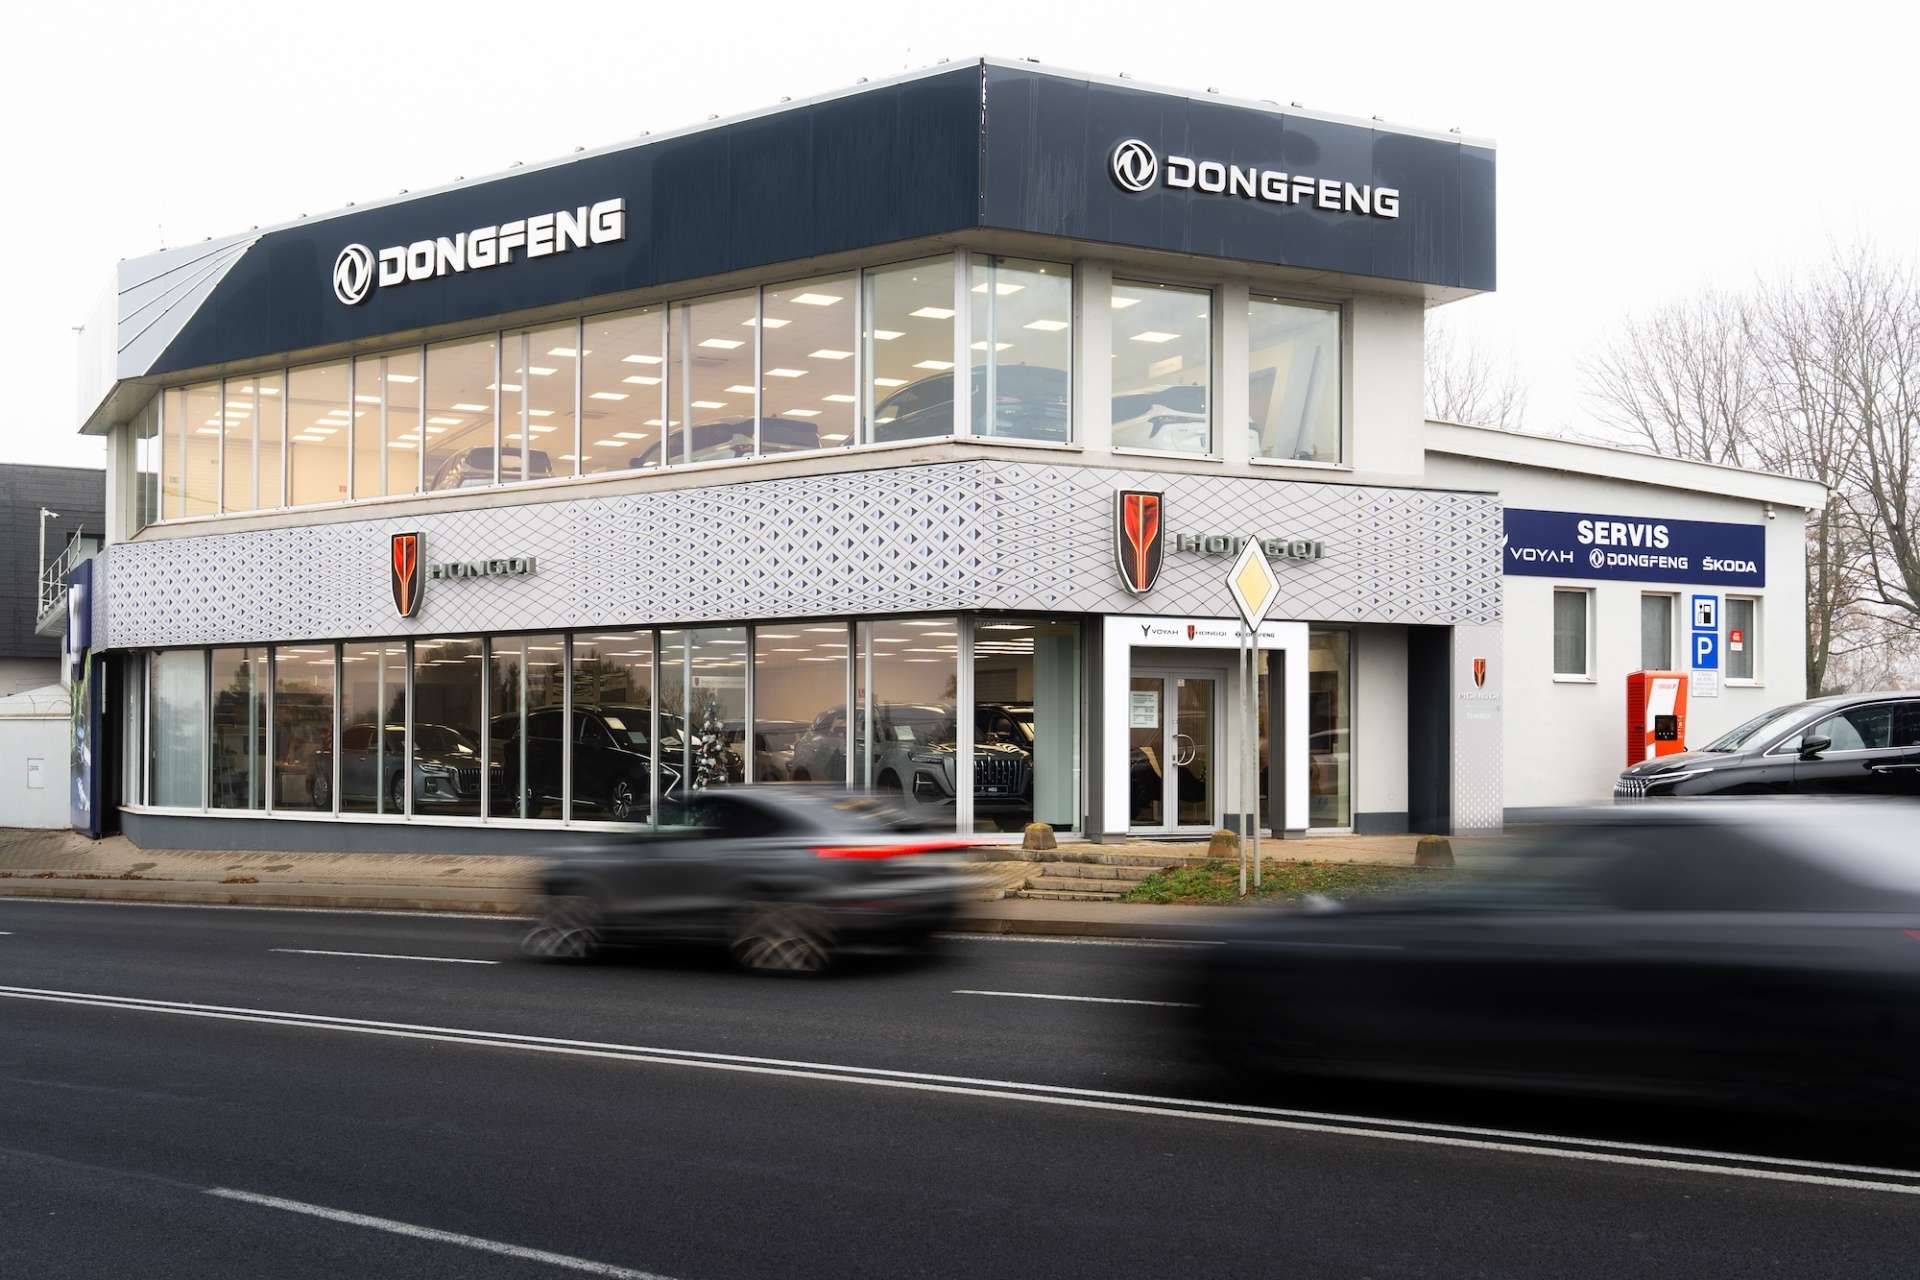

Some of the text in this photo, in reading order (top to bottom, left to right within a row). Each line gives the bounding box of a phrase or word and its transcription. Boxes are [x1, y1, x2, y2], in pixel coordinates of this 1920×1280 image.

[1166, 154, 1399, 218] DONGFENG
[378, 197, 626, 288] DONGFENG
[1577, 519, 1670, 549] SERVIS
[1510, 547, 1757, 573] VOYAH DONGFENG ŠKODA
[1697, 636, 1713, 665] P
